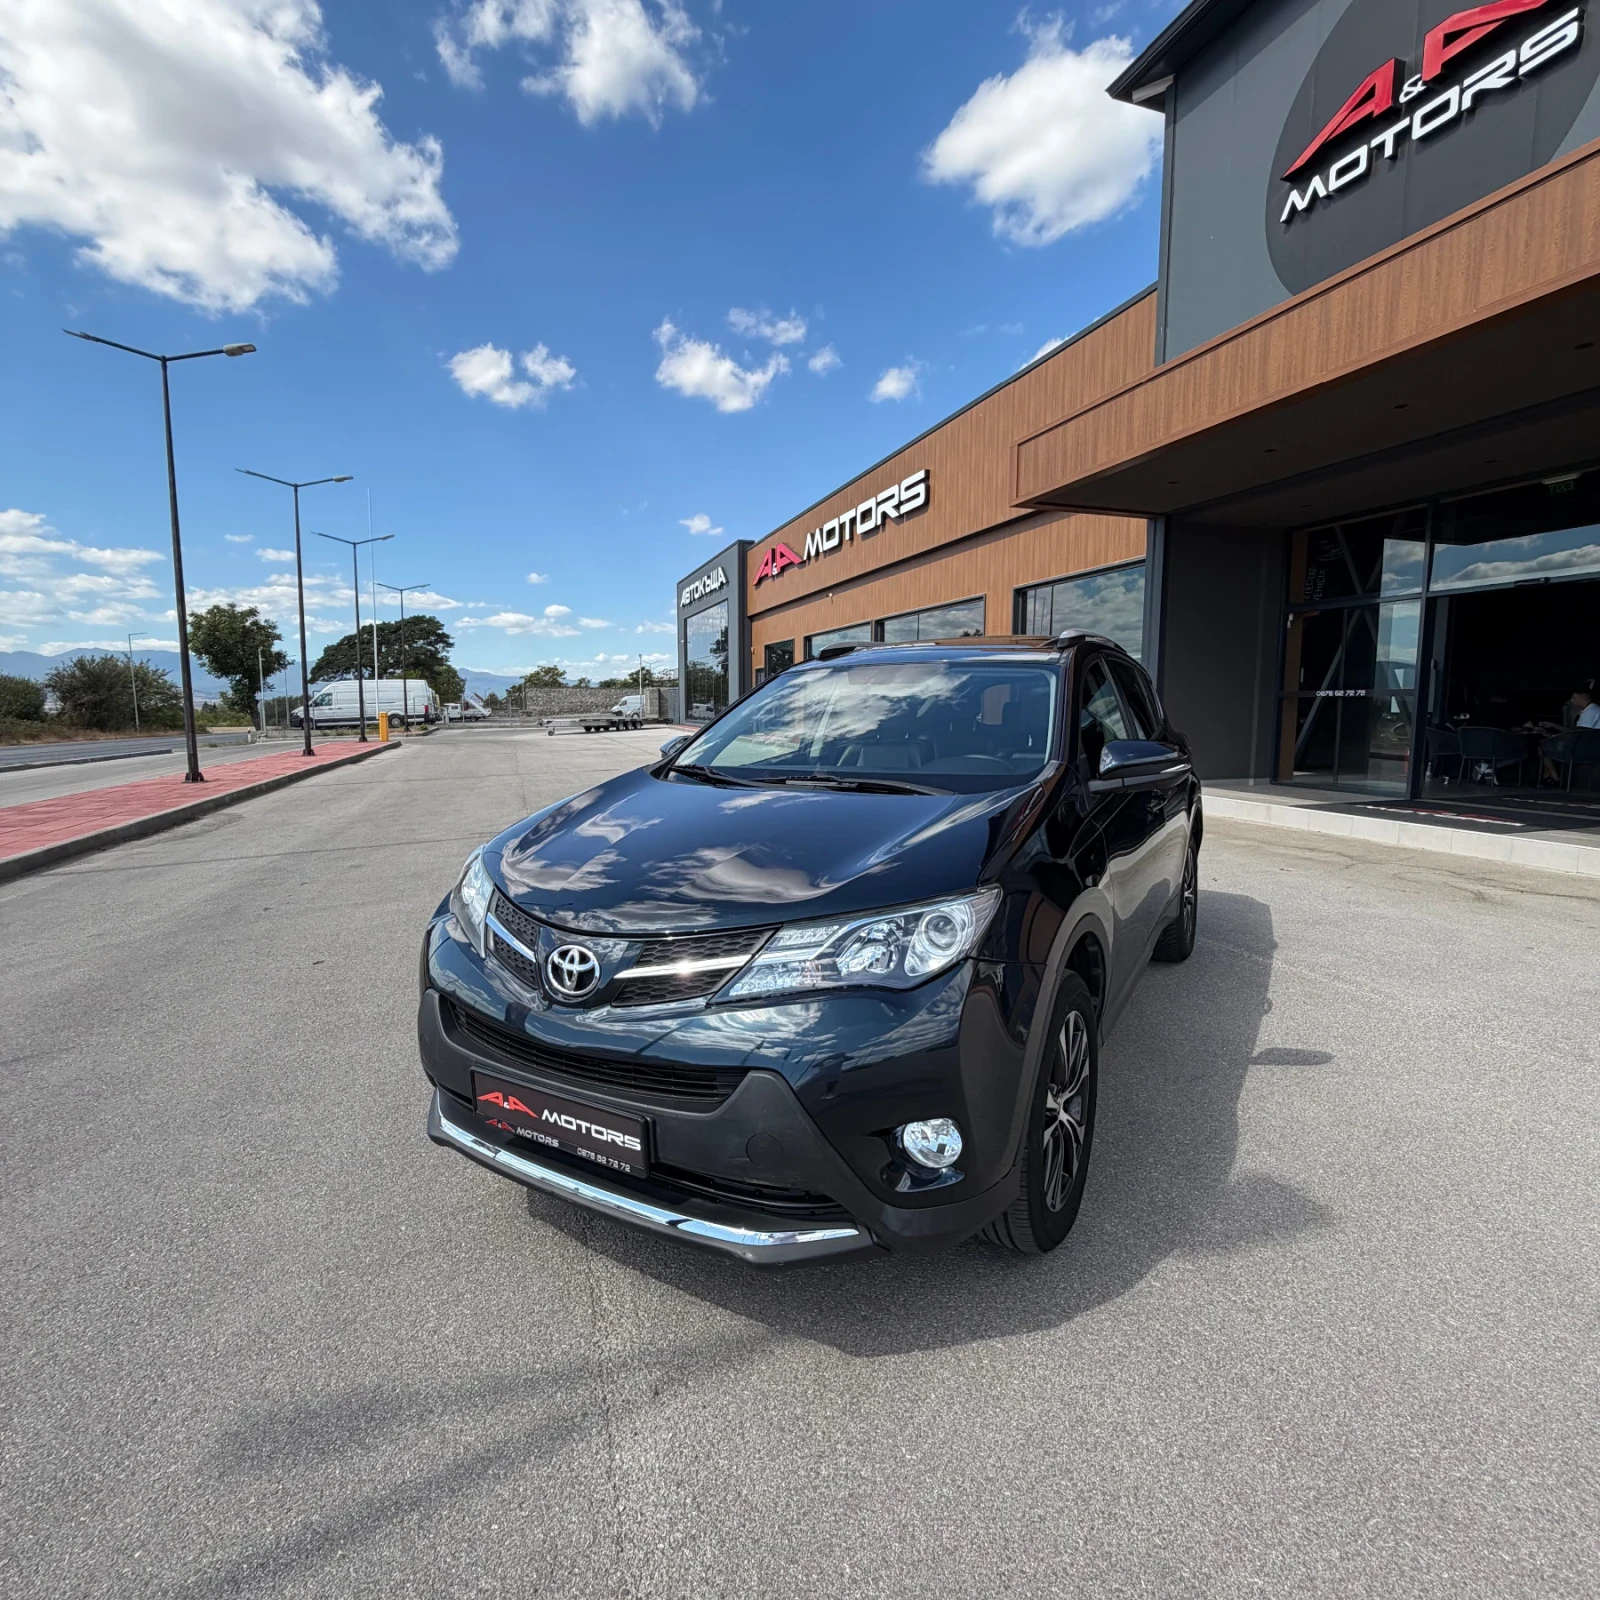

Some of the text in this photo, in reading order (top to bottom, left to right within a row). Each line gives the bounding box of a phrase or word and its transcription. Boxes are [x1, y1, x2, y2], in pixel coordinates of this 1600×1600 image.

[1279, 7, 1580, 224] MOTORS
[753, 469, 927, 586] A&A MOTORS
[680, 566, 726, 608] АВТОКЪЩА
[477, 1091, 641, 1151] A&A MOTORS
[516, 1126, 559, 1148] MOTORS
[608, 1158, 619, 1169] 72
[620, 1162, 631, 1173] 72
